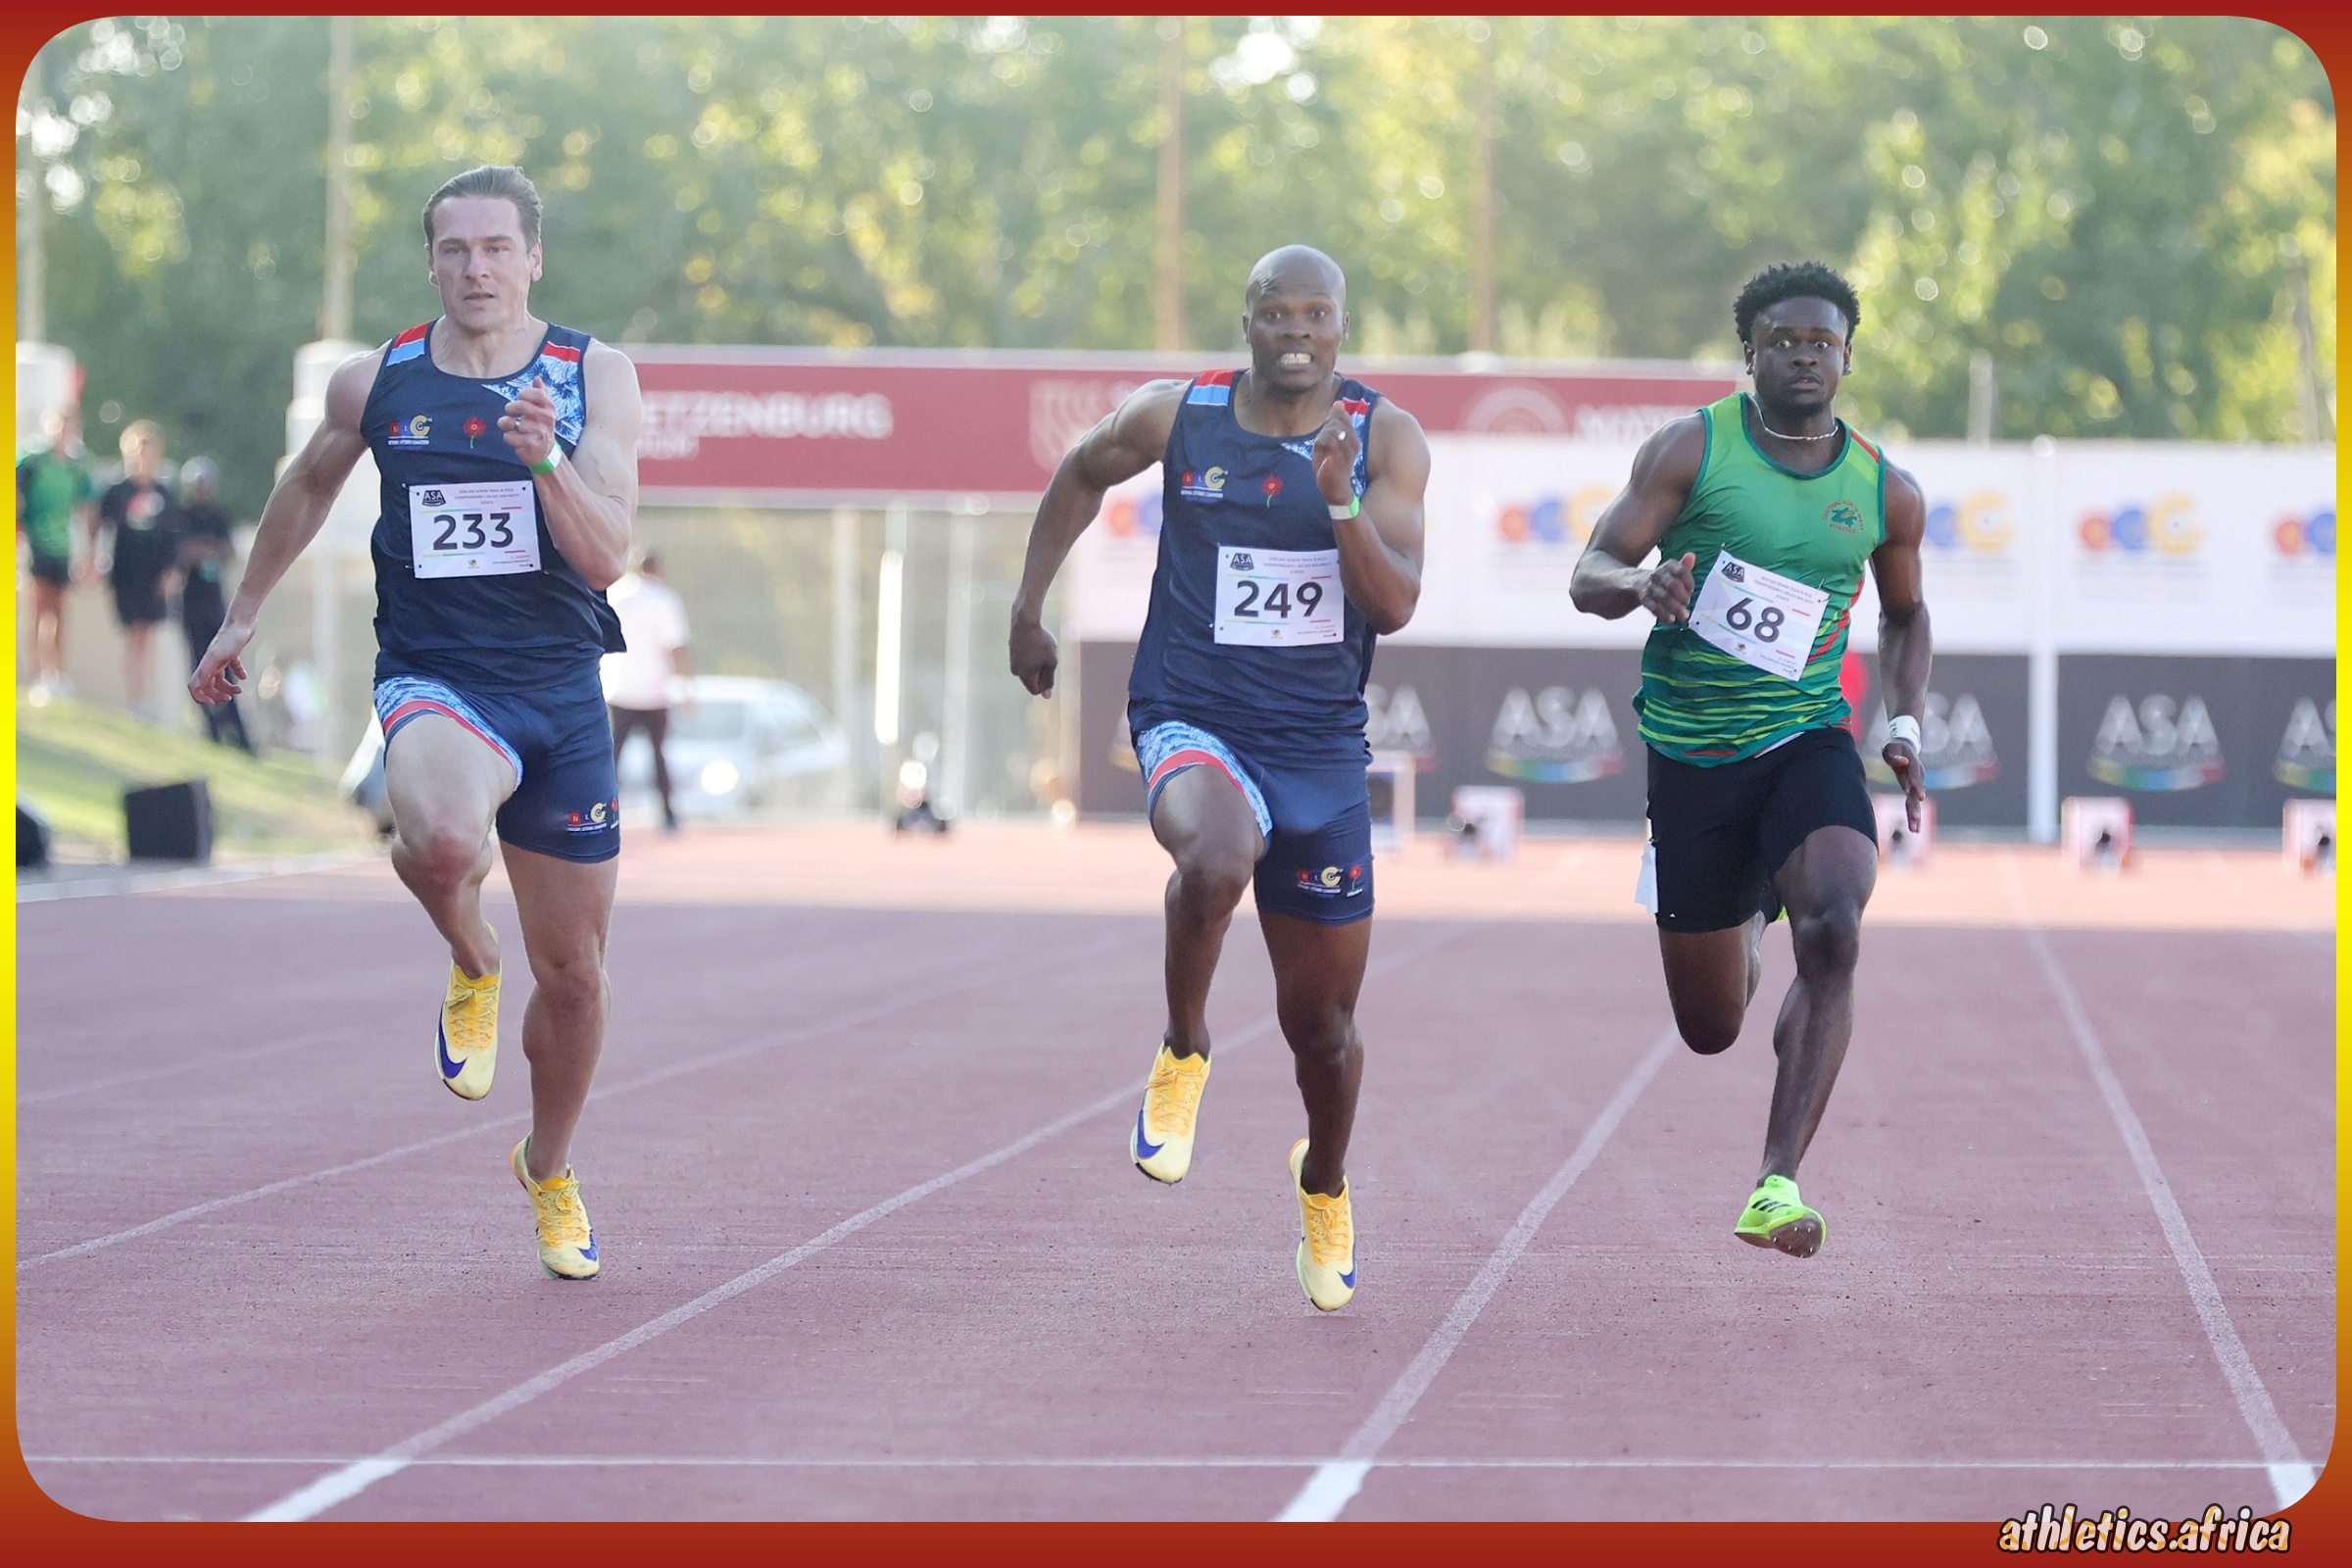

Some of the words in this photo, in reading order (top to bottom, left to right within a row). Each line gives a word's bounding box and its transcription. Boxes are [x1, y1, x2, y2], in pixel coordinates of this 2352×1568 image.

[424, 491, 443, 500] ASA
[433, 513, 514, 551] 233
[1234, 554, 1252, 564] ASA
[1726, 563, 1744, 577] ASA
[1234, 580, 1323, 618] 249
[1727, 597, 1785, 643] 68
[1491, 686, 1619, 750] ASA
[2093, 693, 2223, 756] ASA
